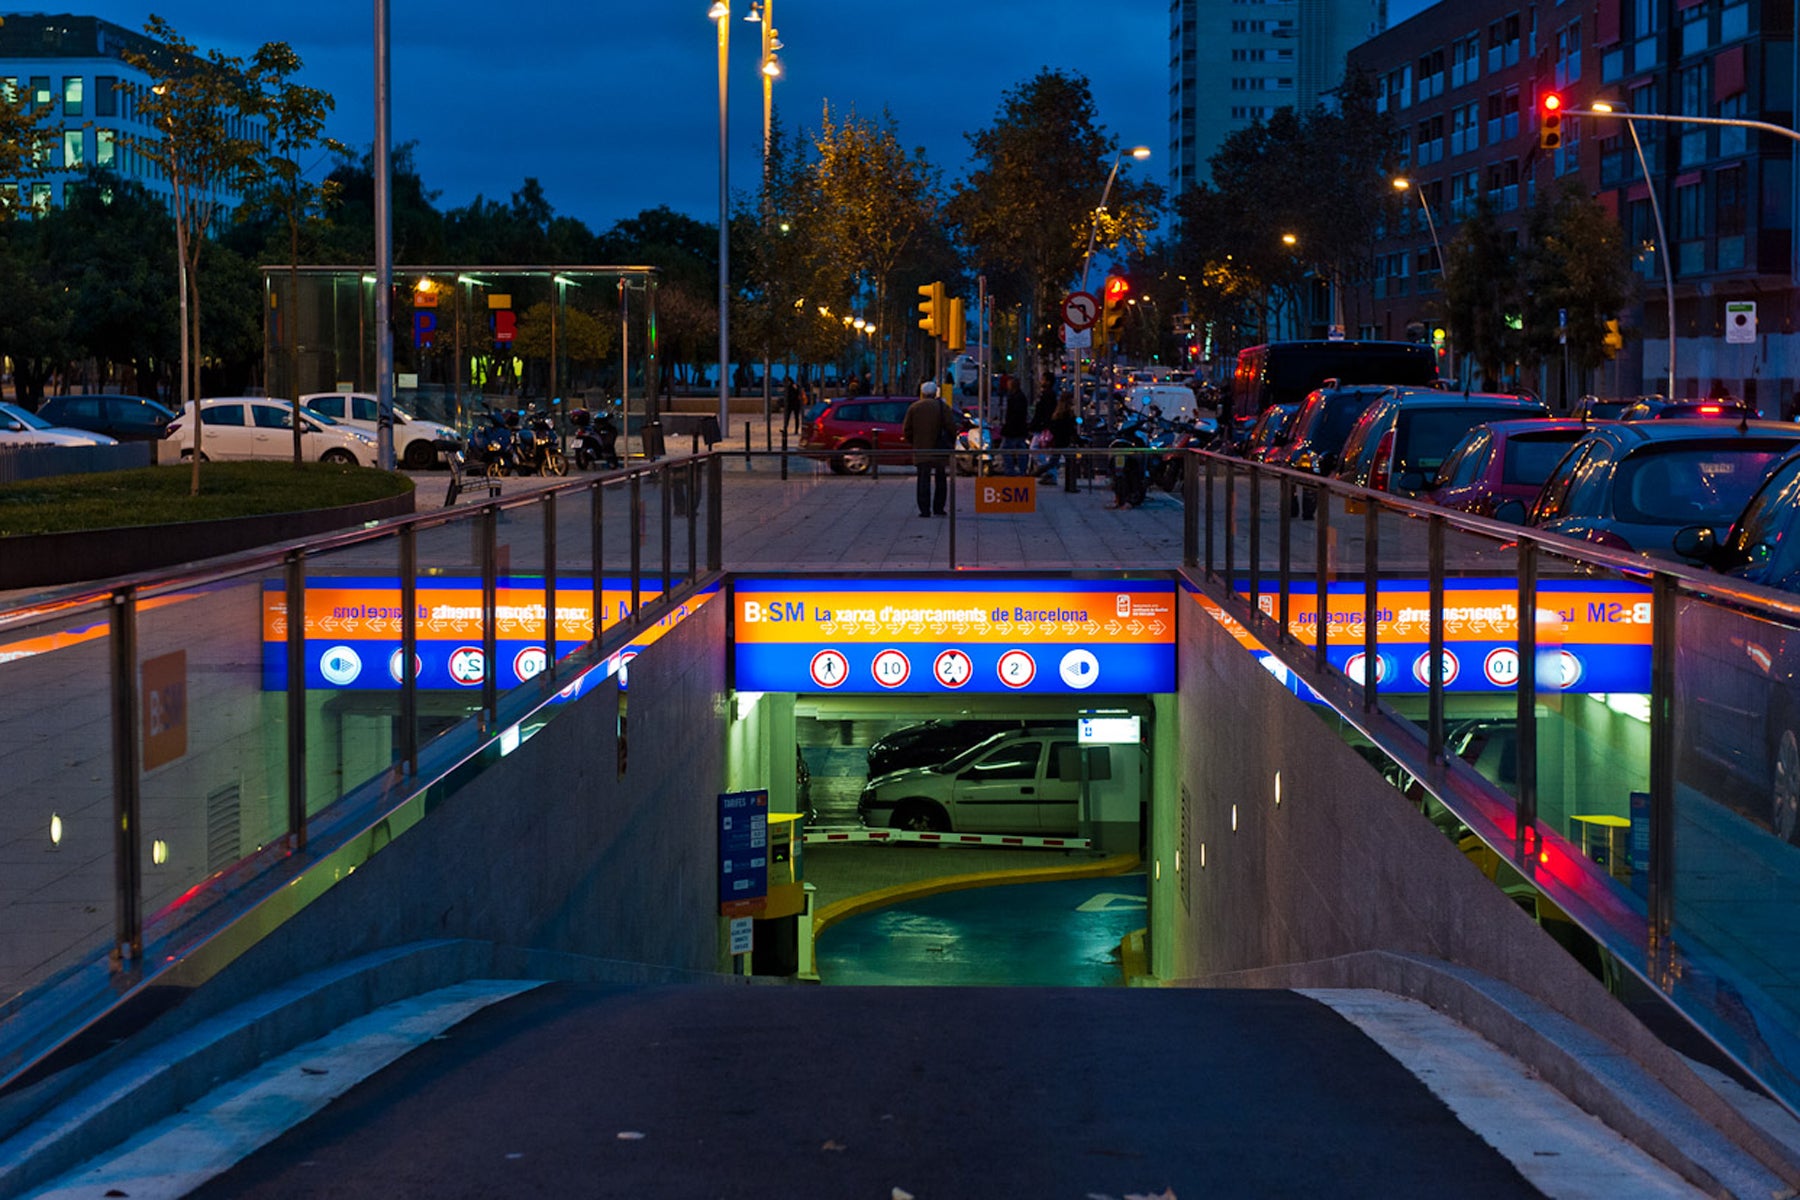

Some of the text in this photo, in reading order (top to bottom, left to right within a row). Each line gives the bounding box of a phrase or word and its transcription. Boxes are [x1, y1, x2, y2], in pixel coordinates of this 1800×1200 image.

[983, 487, 1029, 503] B:SM
[744, 601, 1088, 625] B:SM La xarxa d'aparcaments de Barcelona
[883, 662, 901, 675] 10
